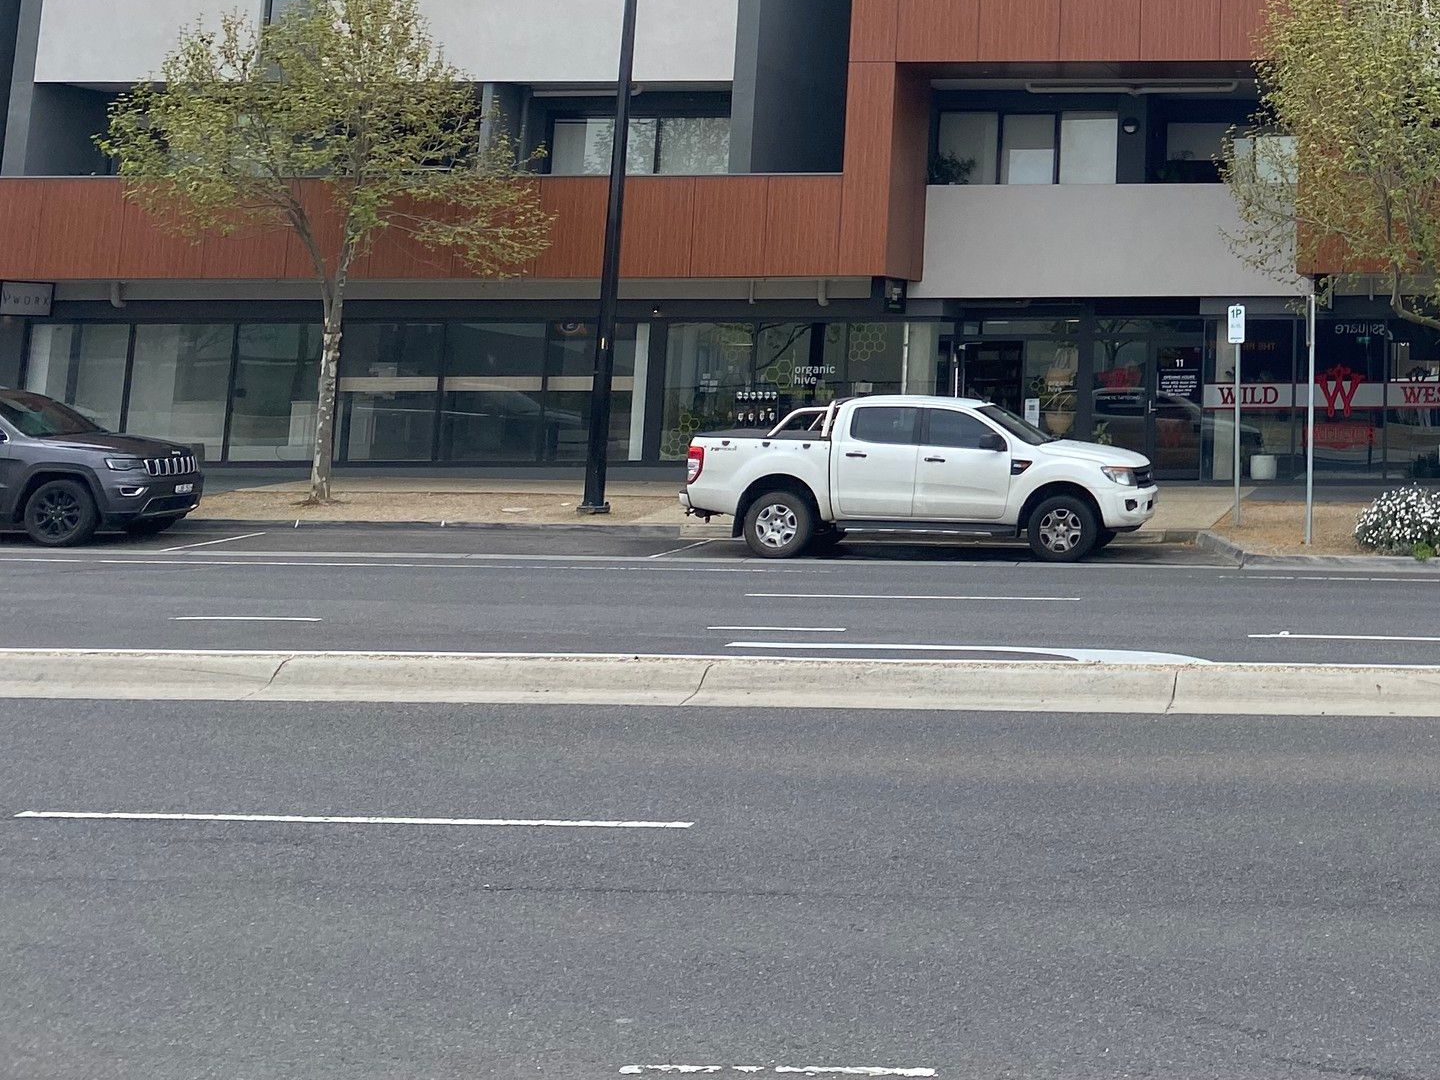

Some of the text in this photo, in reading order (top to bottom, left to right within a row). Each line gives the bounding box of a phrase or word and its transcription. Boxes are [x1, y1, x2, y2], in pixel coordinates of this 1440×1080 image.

[1231, 308, 1242, 319] 1P
[1175, 358, 1184, 368] 11
[794, 363, 836, 377] organic
[794, 375, 817, 385] hive
[1218, 386, 1279, 405] WILD
